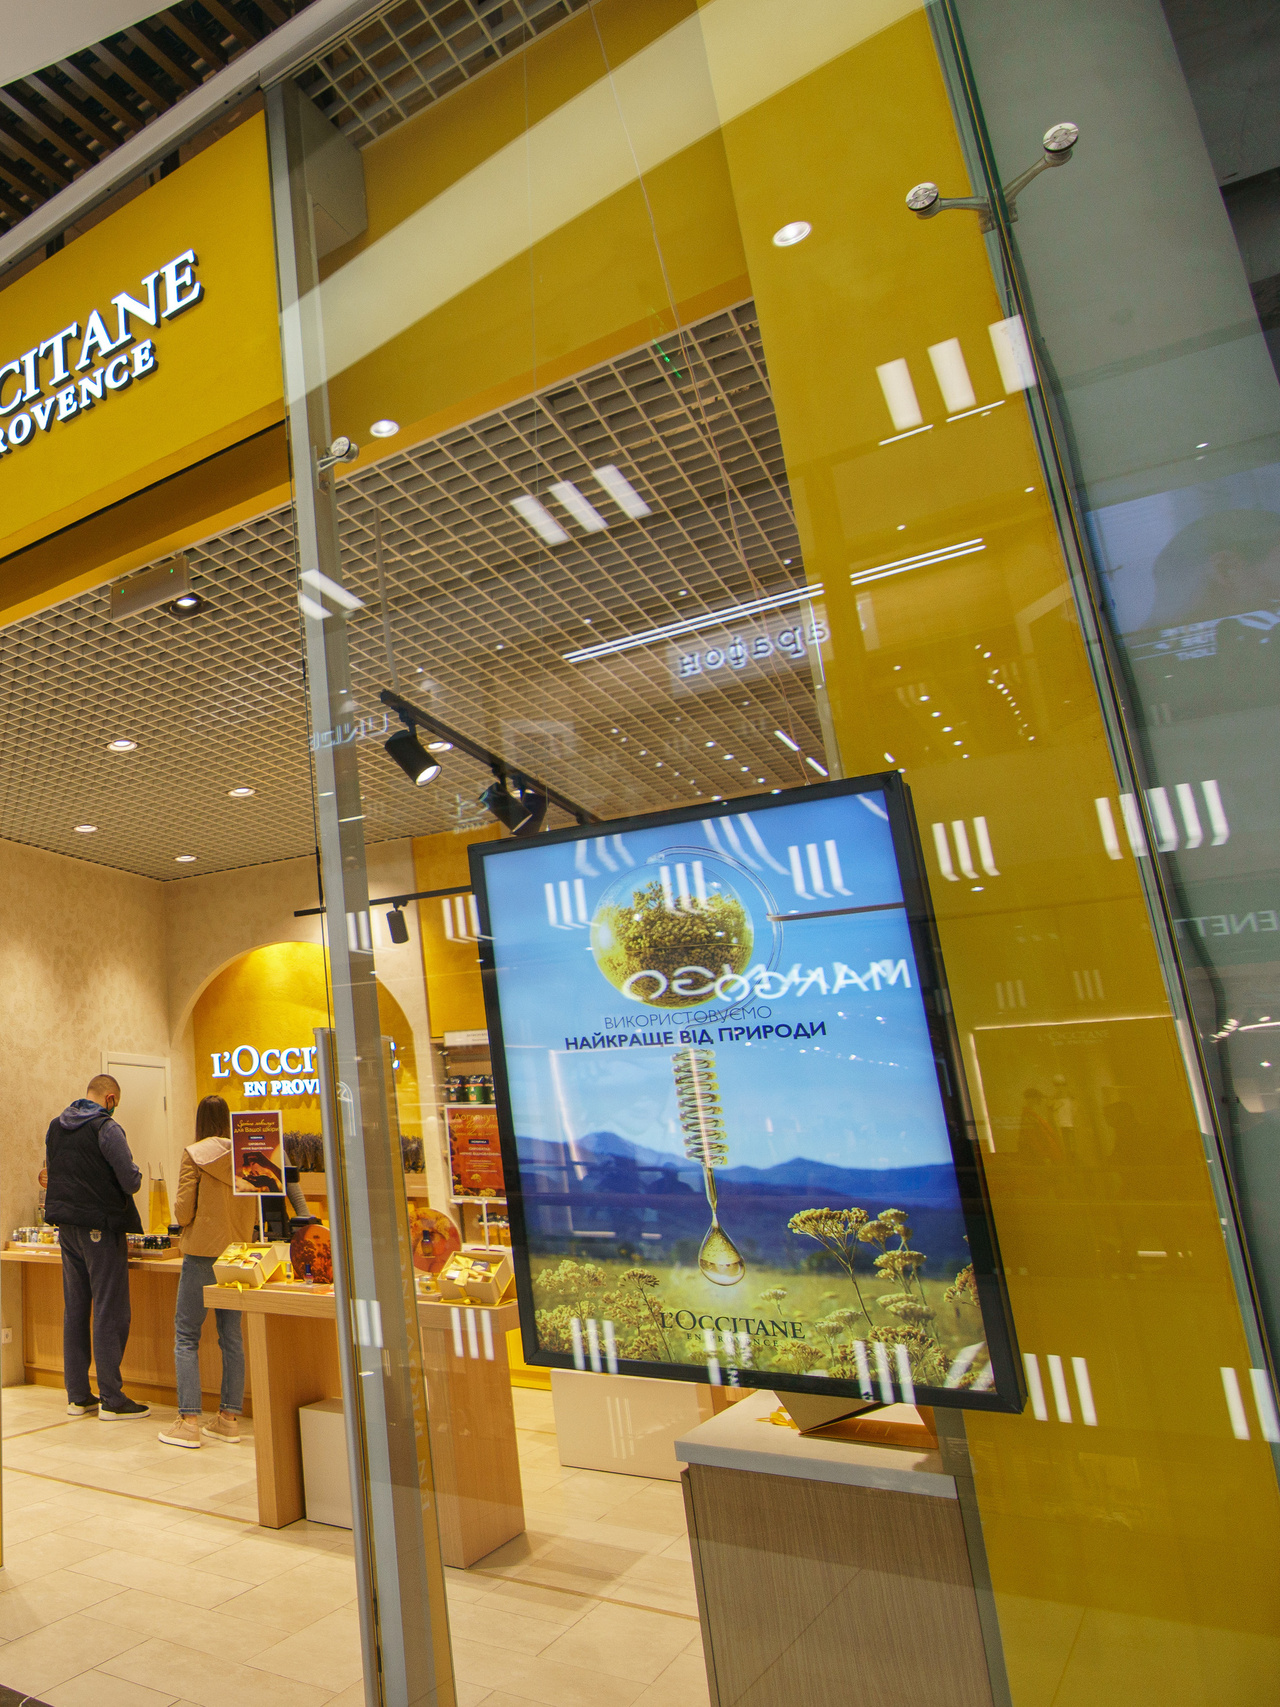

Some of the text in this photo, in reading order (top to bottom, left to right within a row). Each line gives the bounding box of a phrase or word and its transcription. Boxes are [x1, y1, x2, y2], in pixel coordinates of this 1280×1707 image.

[604, 1005, 772, 1030] ВИКОРИСТОВУЄМО
[565, 1020, 827, 1050] НАЙКРАЩЕ ВІД ПРИРОДИ
[211, 1044, 318, 1078] L'OCCI
[243, 1081, 268, 1097] EN
[454, 1113, 498, 1122] Доглянут
[660, 1309, 805, 1339] L'OCCITANE
[687, 1333, 702, 1341] EN
